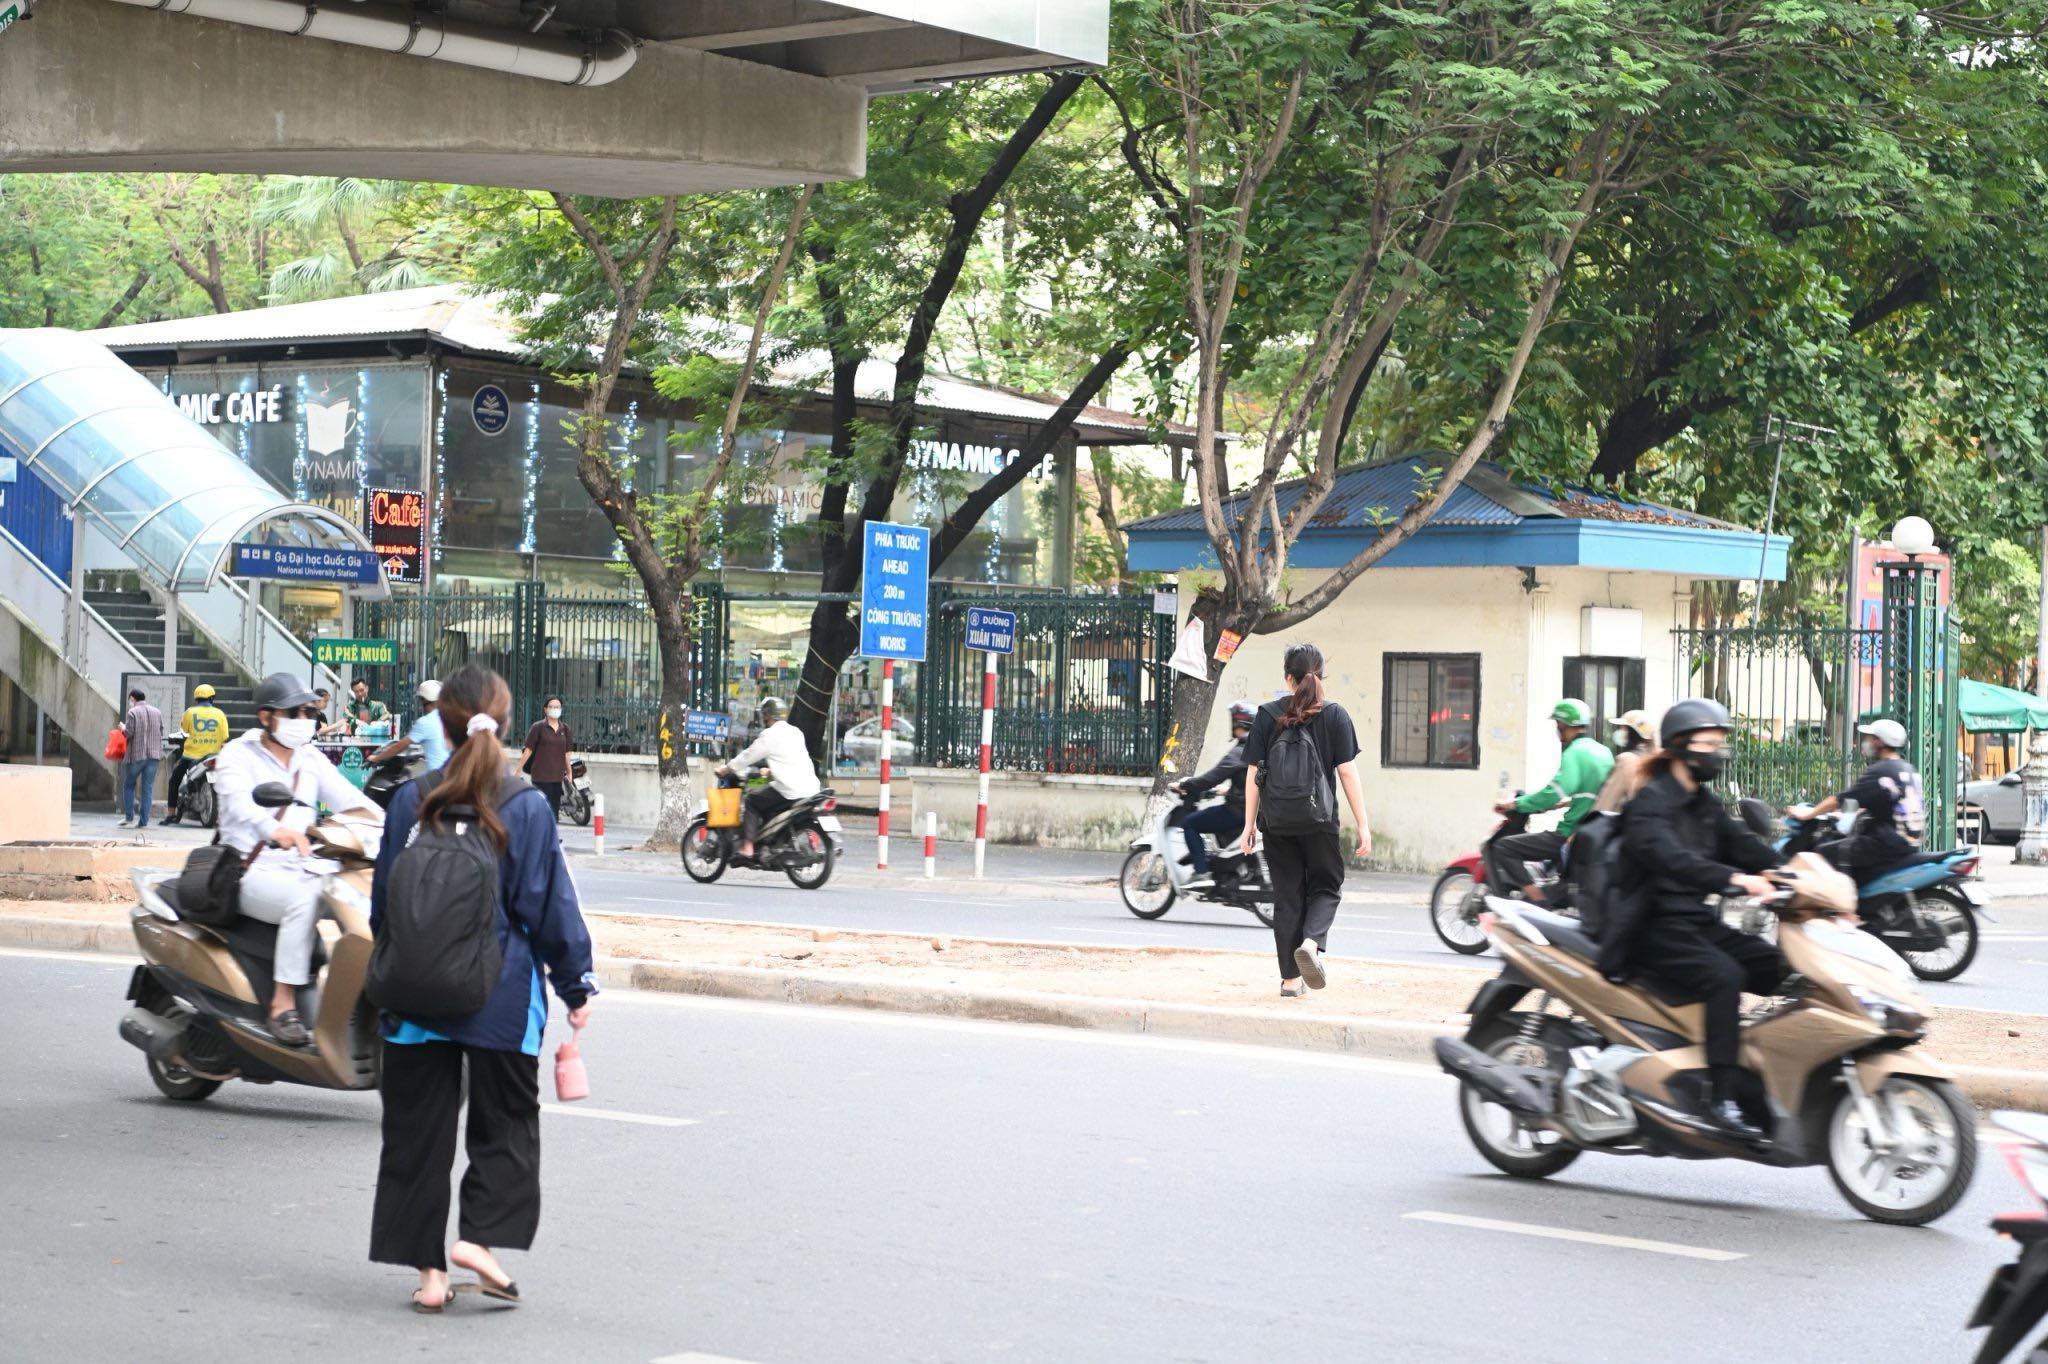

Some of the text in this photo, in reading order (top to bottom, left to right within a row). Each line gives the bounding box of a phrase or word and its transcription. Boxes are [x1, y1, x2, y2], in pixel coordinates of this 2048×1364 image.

[226, 384, 281, 423] CAFÉ
[906, 439, 1004, 475] DYNAMIC
[293, 460, 368, 480] DYNAMIC
[746, 487, 822, 510] DYNAMIC
[373, 493, 421, 527] Café
[875, 531, 893, 548] PHÍA
[275, 551, 361, 567] Ga Đại học Quốc Gia
[882, 559, 908, 575] AHEAD
[277, 566, 359, 578] National University Station
[867, 607, 889, 624] CÔNG
[982, 615, 1010, 627] ĐƯỜNG
[880, 635, 906, 652] WORKS
[969, 629, 1011, 649] XUÂN THỦY
[317, 642, 392, 662] CÀ PHÊ MUỐI
[192, 713, 218, 732] be
